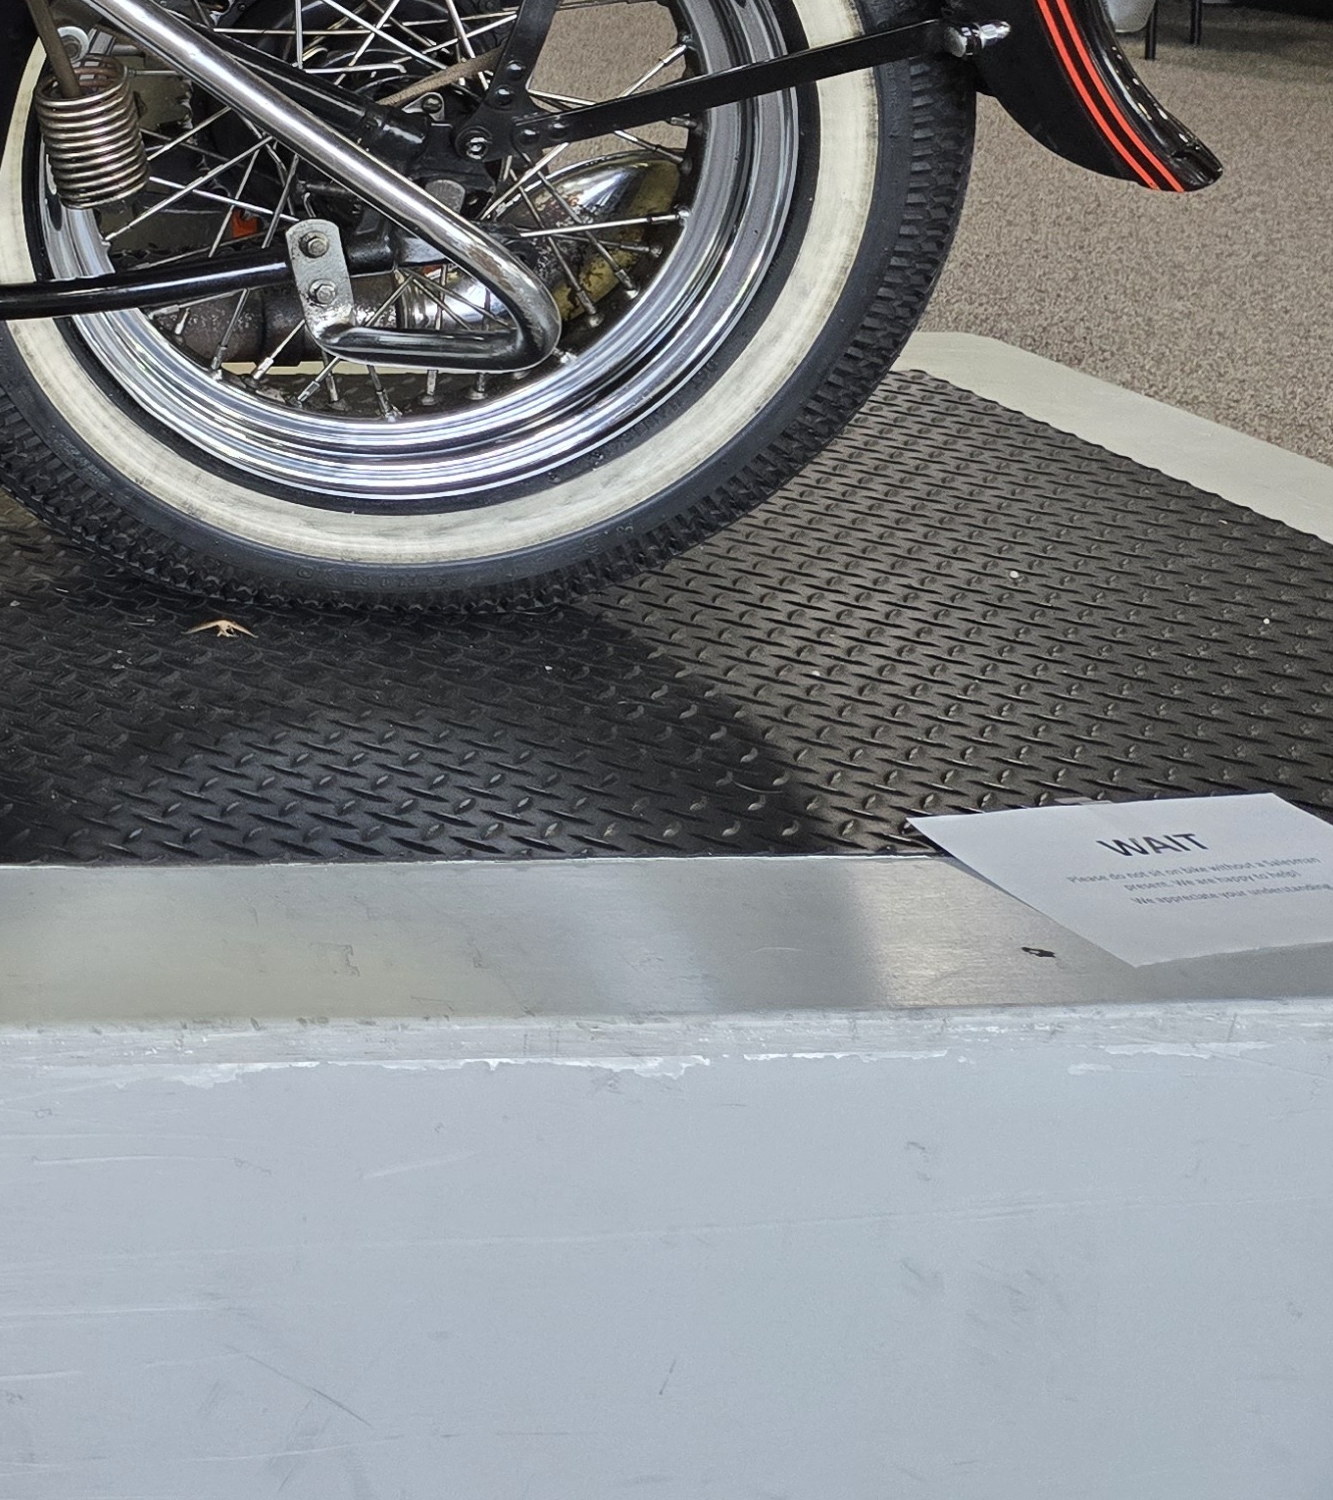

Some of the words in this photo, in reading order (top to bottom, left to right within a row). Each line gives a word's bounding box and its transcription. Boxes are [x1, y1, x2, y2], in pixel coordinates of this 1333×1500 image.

[1096, 833, 1209, 857] WAIT
[1067, 873, 1106, 884] Please
[1108, 872, 1125, 881] do
[1126, 870, 1148, 879] not
[1149, 869, 1165, 878] sit
[1182, 865, 1209, 875] bike
[1209, 861, 1258, 872] without
[1259, 860, 1267, 868] a
[1265, 856, 1322, 868] Salesman
[1174, 878, 1193, 887] We
[1195, 877, 1215, 885] are
[1216, 873, 1256, 884] happy
[1253, 871, 1269, 880] to
[1131, 897, 1153, 905] We
[1155, 891, 1217, 905] appreciate
[1218, 890, 1247, 900] your
